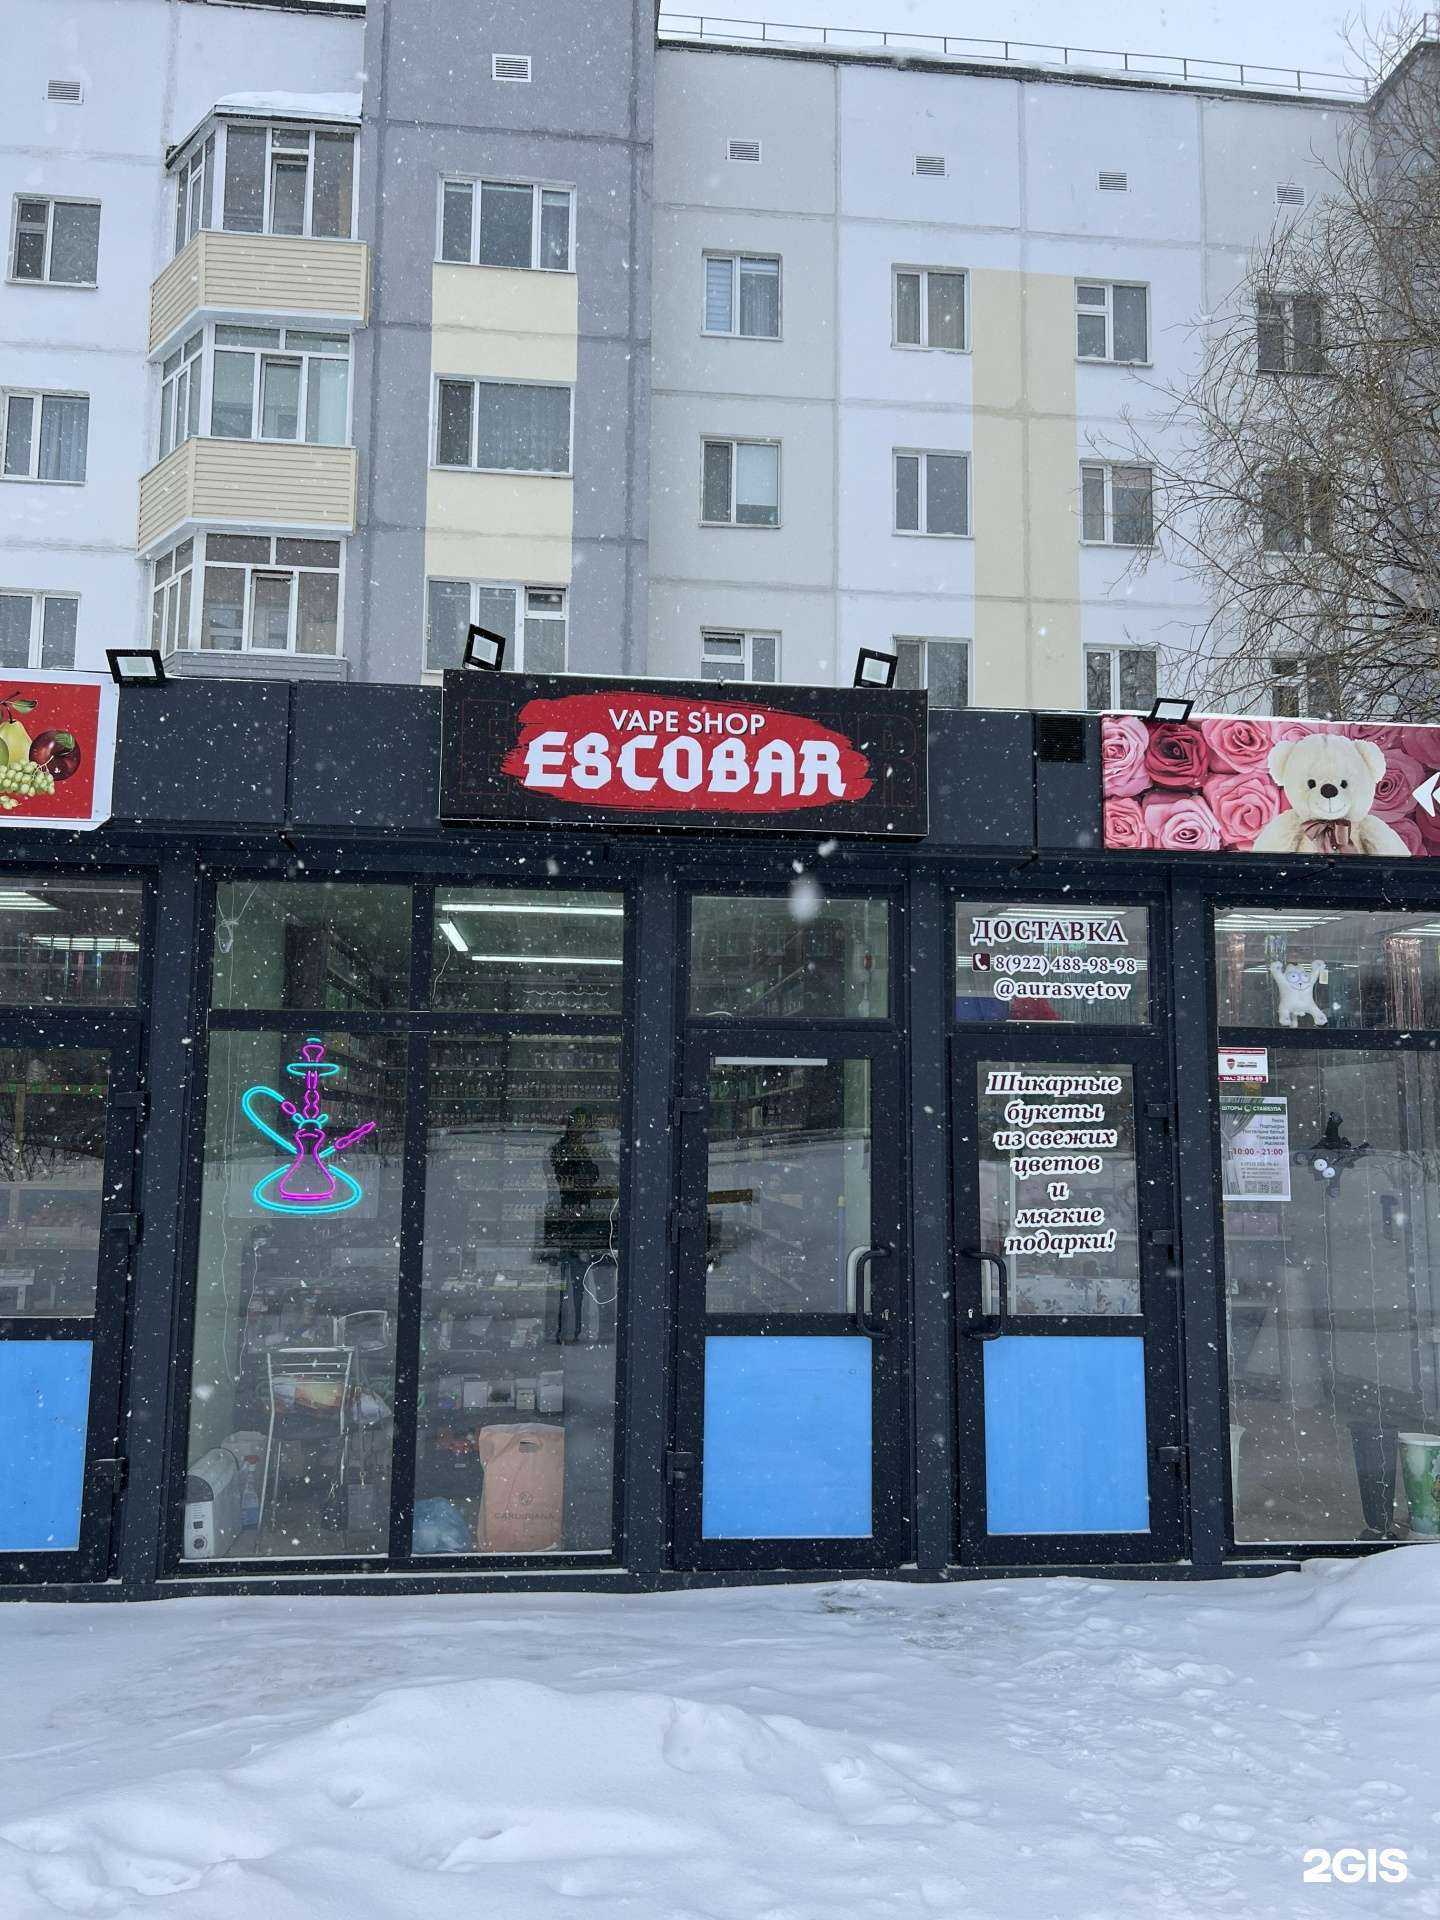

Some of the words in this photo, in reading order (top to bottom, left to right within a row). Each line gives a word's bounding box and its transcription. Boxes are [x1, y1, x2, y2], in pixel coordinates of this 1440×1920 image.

[608, 708, 678, 733] VAPE
[688, 711, 765, 736] SHOP
[523, 731, 847, 797] ESCOBAR
[971, 918, 1128, 945] ДОСТАВКА
[994, 956, 1048, 974] 8(922)
[1051, 956, 1137, 974] 488-98-98
[995, 978, 1131, 1000] @aurasvetov
[986, 1072, 1121, 1096] Шикарные
[1005, 1101, 1104, 1126] букеты
[995, 1131, 1024, 1149] из
[1028, 1129, 1116, 1148] свежих
[1232, 1147, 1254, 1155] 10:00
[1012, 1156, 1102, 1179] цветов
[1049, 1182, 1069, 1200] и
[1015, 1207, 1104, 1227] мягкие
[1006, 1229, 1116, 1258] подарки!
